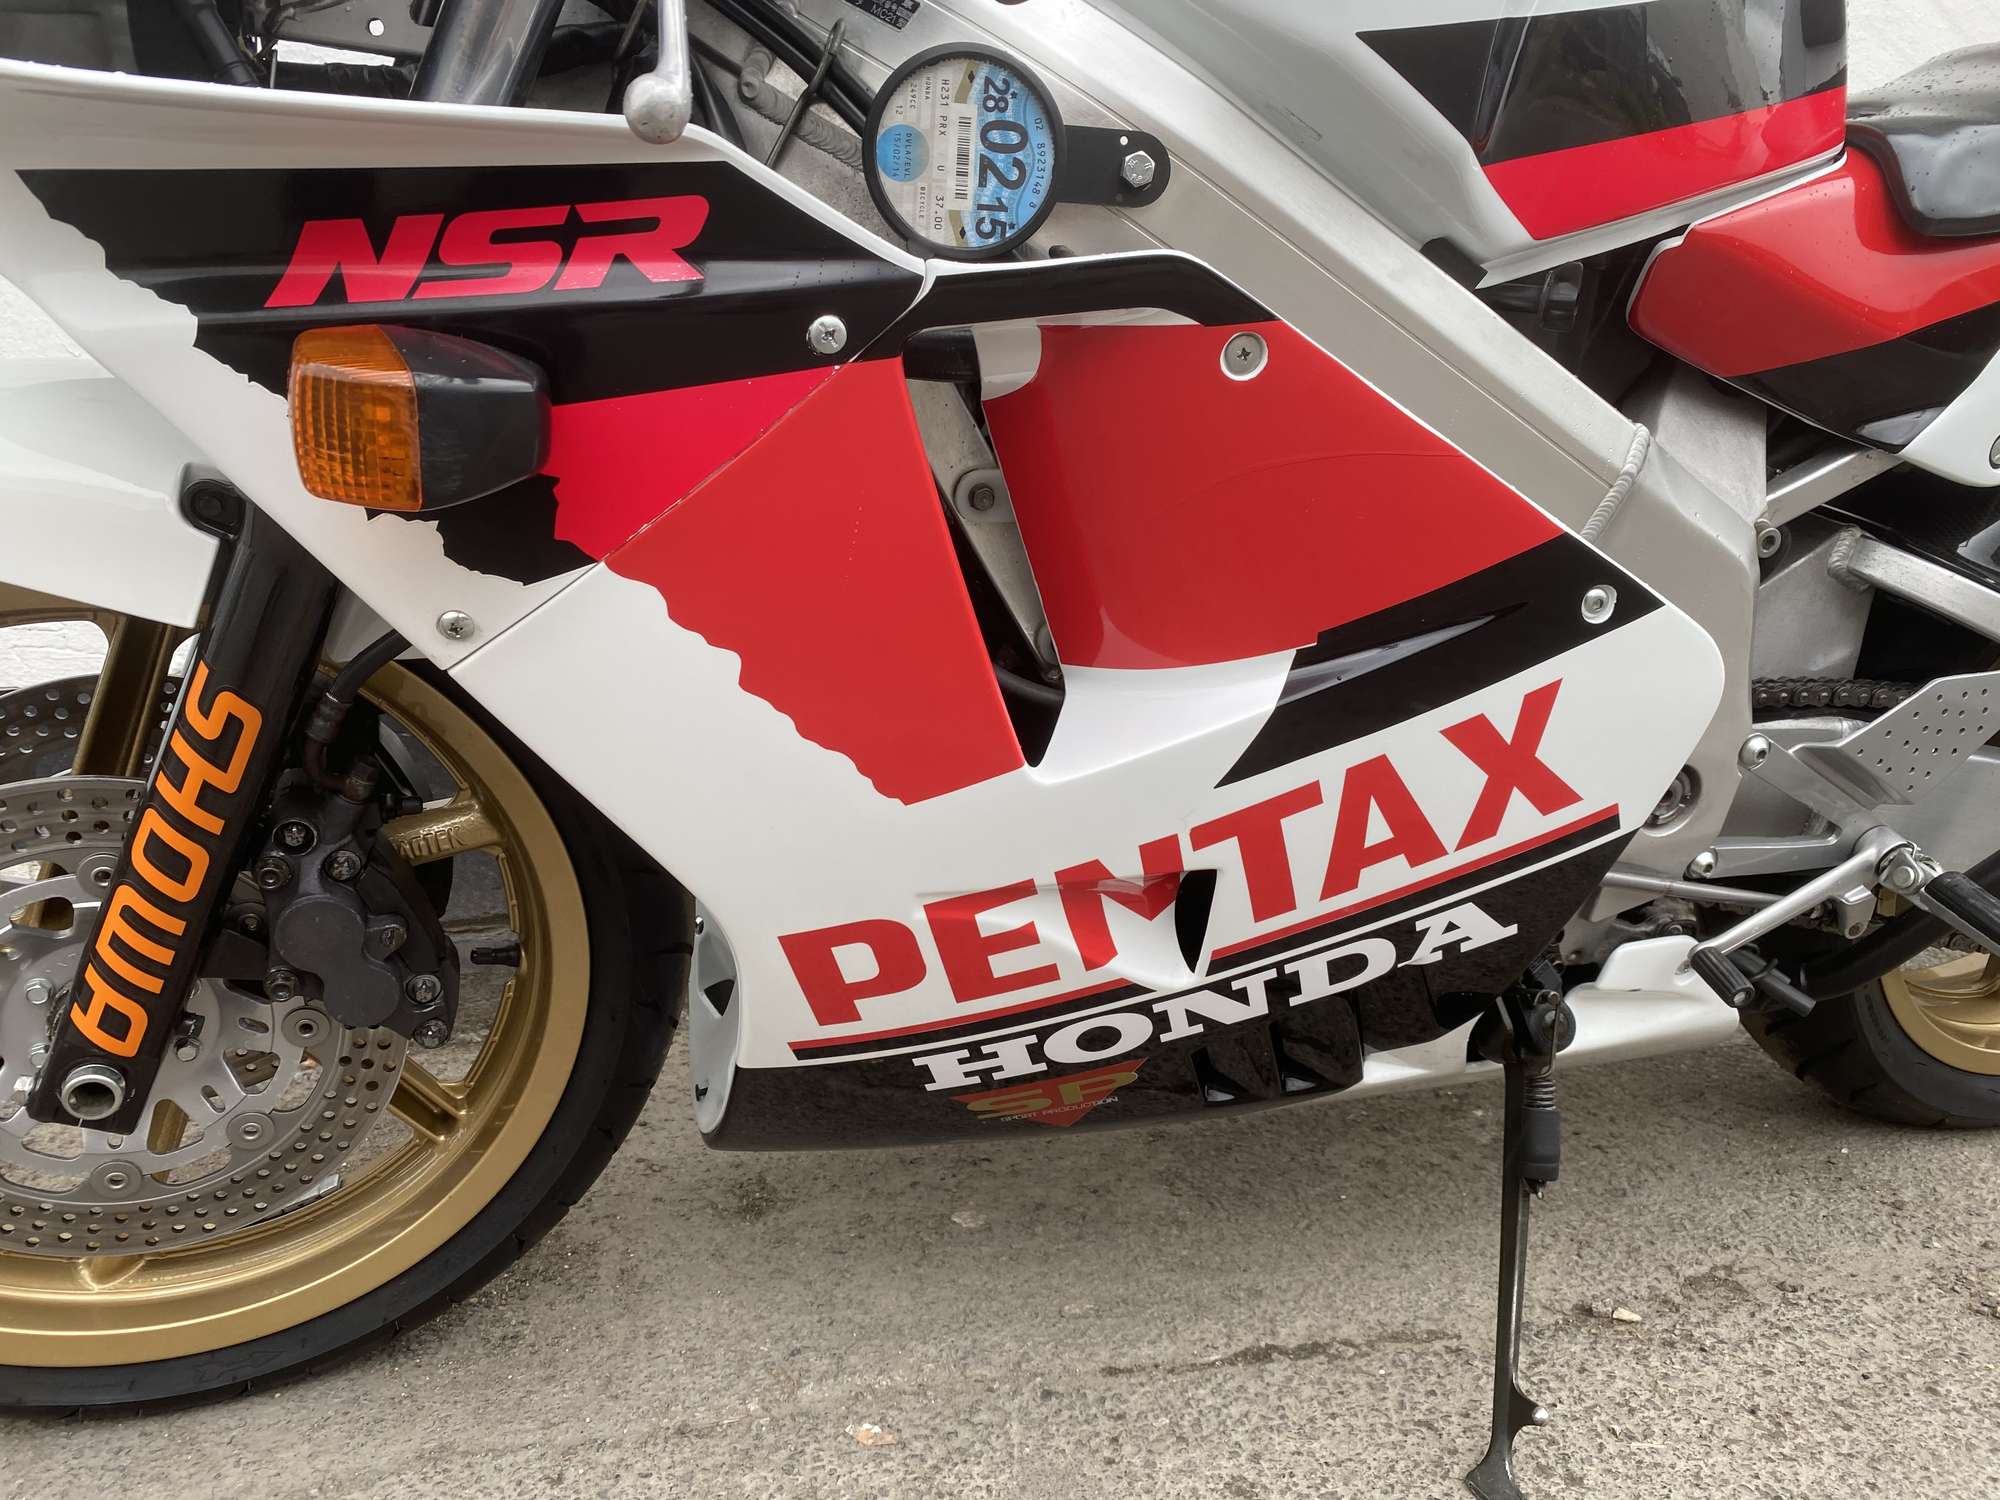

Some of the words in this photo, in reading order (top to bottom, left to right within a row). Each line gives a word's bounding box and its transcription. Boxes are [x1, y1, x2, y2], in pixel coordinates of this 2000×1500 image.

[870, 4, 898, 24] MC21
[895, 105, 903, 115] 12
[940, 79, 950, 107] H231
[983, 76, 1010, 113] 28
[938, 115, 948, 136] PRX
[1034, 117, 1044, 131] 02
[978, 120, 1028, 190] 02
[1031, 143, 1047, 195] 8923148
[934, 195, 944, 231] 37.00
[975, 197, 1008, 239] 15
[264, 195, 710, 308] NSR
[71, 664, 264, 1057] SHOWA
[779, 680, 1583, 1026] PENTAX
[912, 902, 1518, 1092] HONDA
[966, 1071, 1138, 1120] SP
